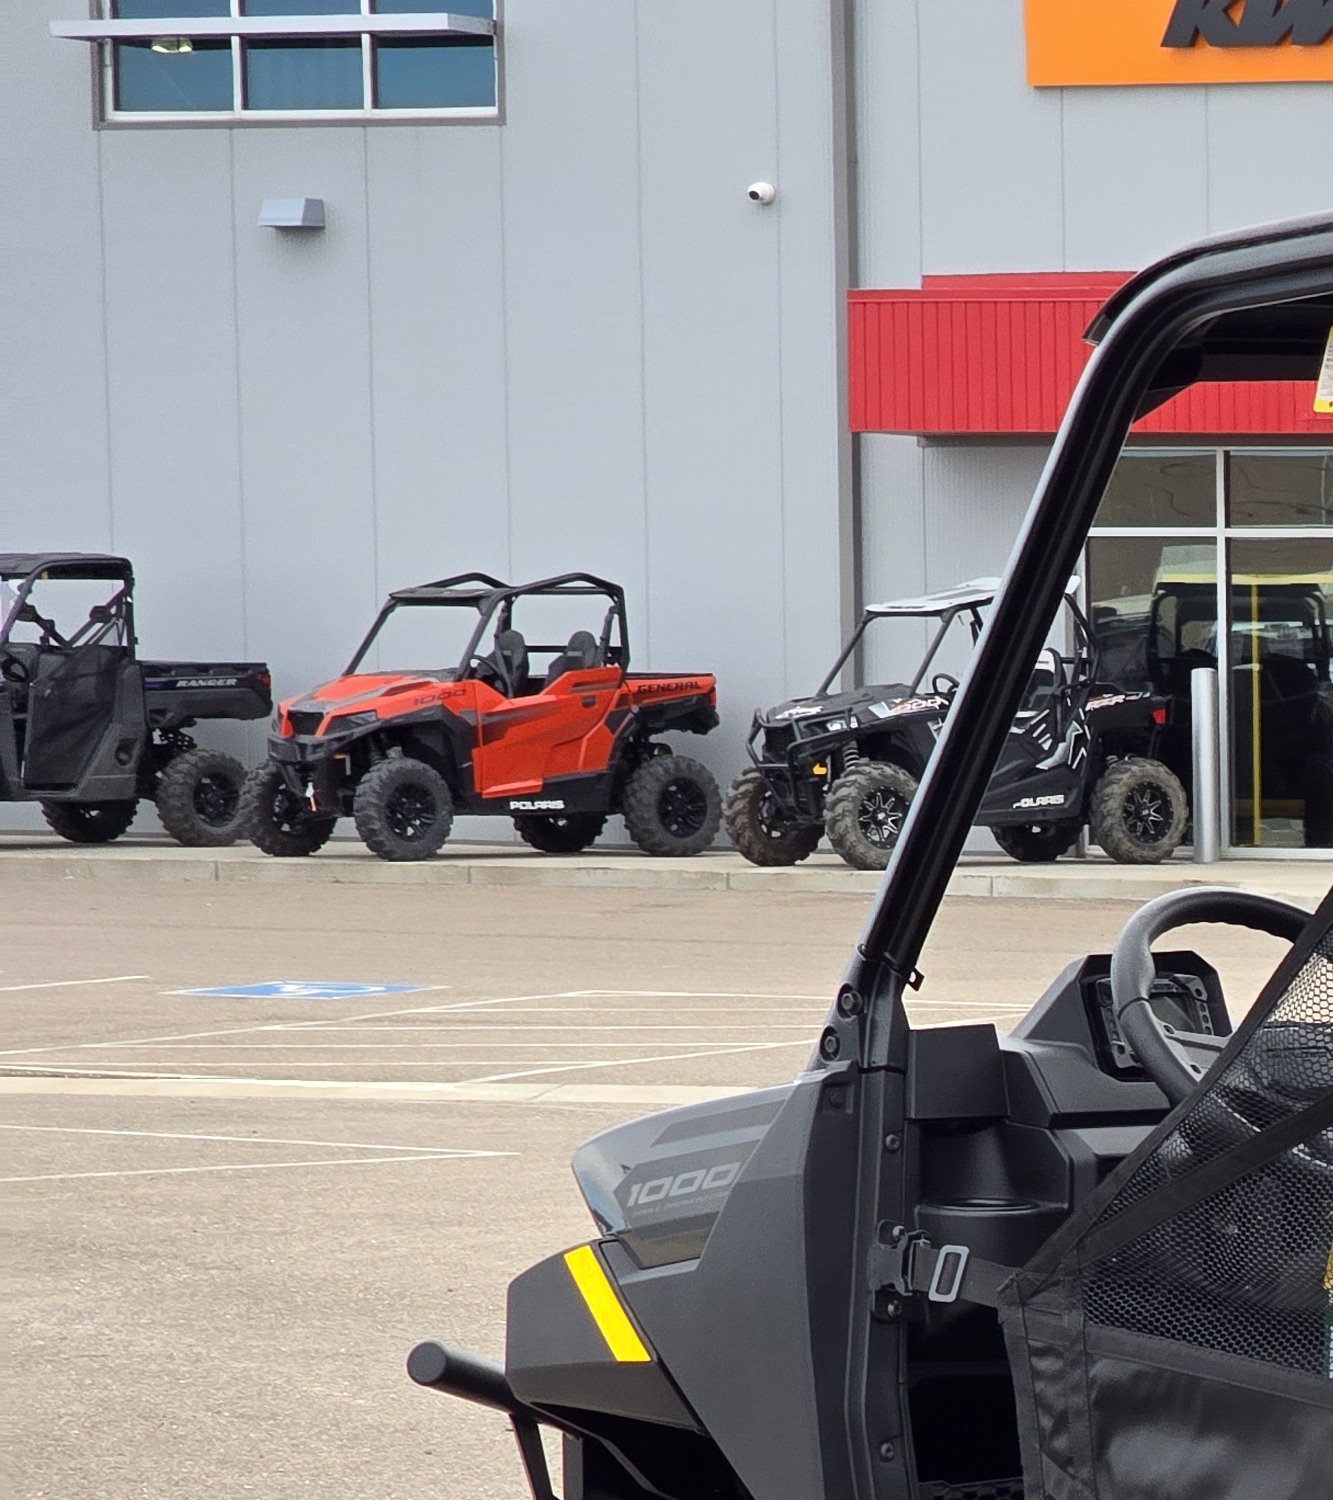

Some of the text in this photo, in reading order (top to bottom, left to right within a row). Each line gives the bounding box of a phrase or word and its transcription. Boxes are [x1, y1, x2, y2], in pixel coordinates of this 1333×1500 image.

[637, 682, 703, 695] GENERAL
[510, 799, 565, 811] POLARIS
[627, 1162, 742, 1207] 1000
